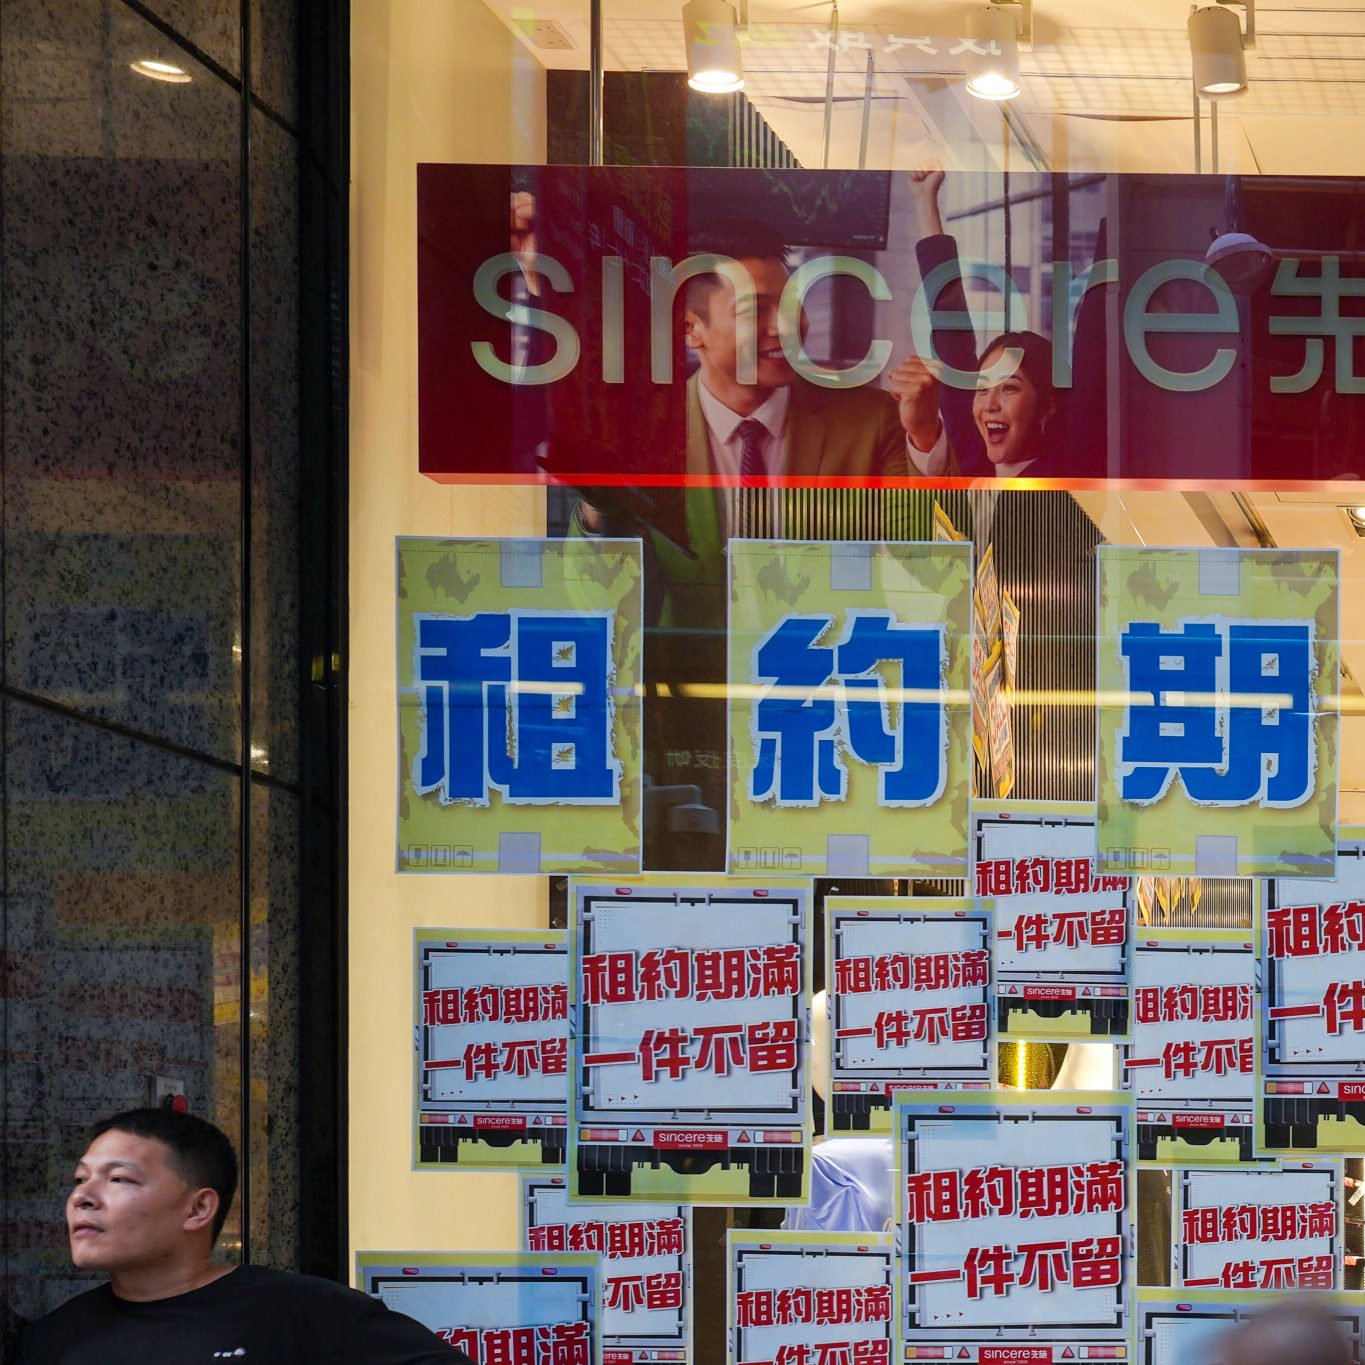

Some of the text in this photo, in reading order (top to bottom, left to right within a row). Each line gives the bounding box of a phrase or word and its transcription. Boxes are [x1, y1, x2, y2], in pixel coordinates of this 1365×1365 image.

[470, 250, 1242, 393] sincere
[582, 942, 802, 1006] 租約期滿
[834, 949, 991, 997] 租約期滿
[582, 1017, 799, 1083] 一件不留
[836, 1002, 988, 1050] 一件不留
[906, 1160, 1126, 1223] 租約期滿
[1181, 1201, 1337, 1246] 租約期滿
[909, 1235, 1123, 1300] 一件不留
[1183, 1254, 1336, 1290] 一件不留
[735, 1285, 892, 1328] 租約期滿
